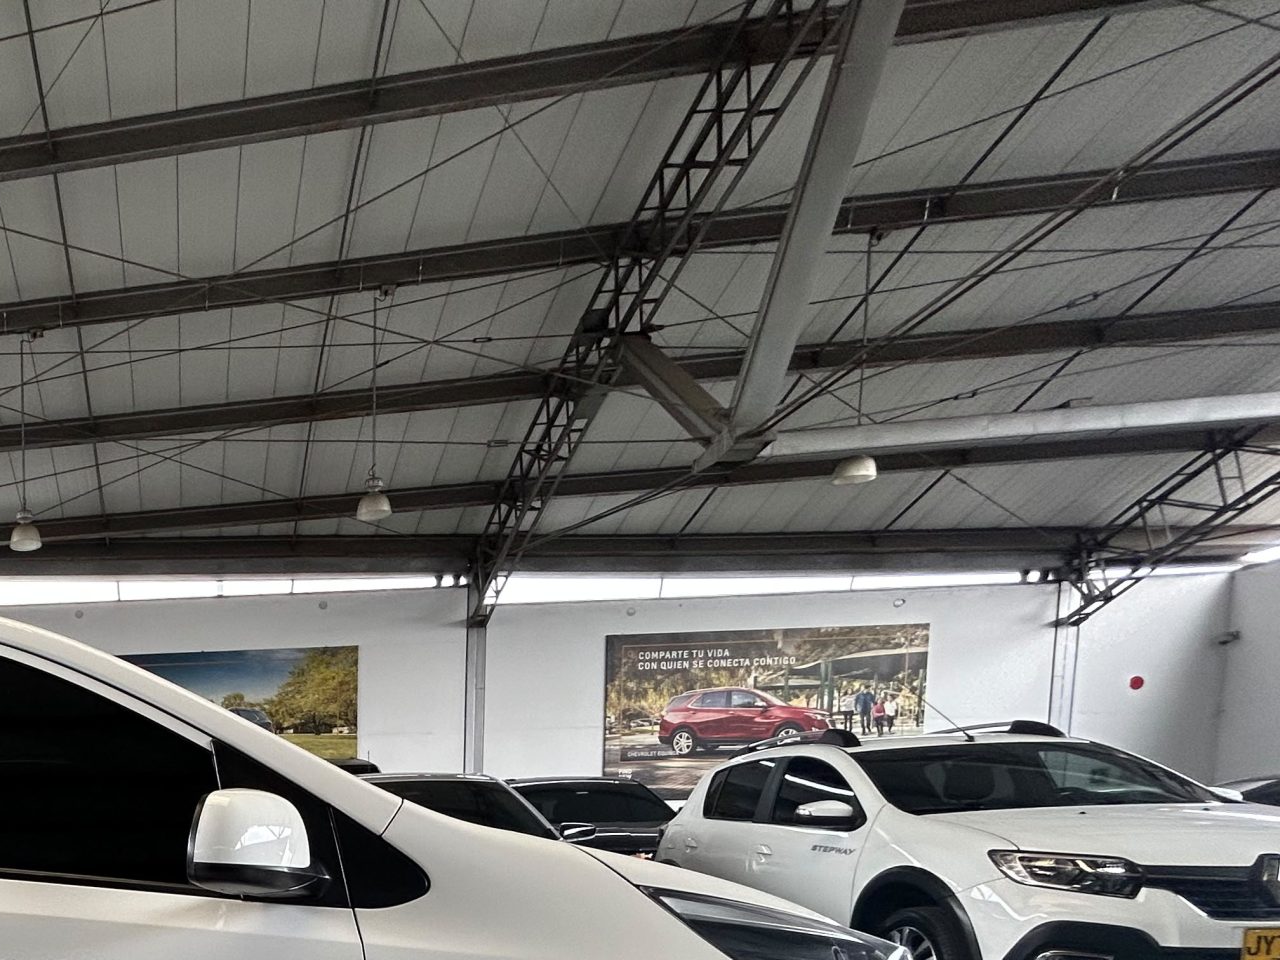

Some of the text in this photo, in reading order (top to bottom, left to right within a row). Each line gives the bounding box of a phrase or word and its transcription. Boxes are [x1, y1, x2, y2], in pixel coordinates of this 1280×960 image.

[638, 648, 730, 660] COMPARTE TU VIDA
[638, 656, 796, 670] CON QUIEN SE CONECTA CONTIGO
[810, 844, 856, 856] STEPWAY
